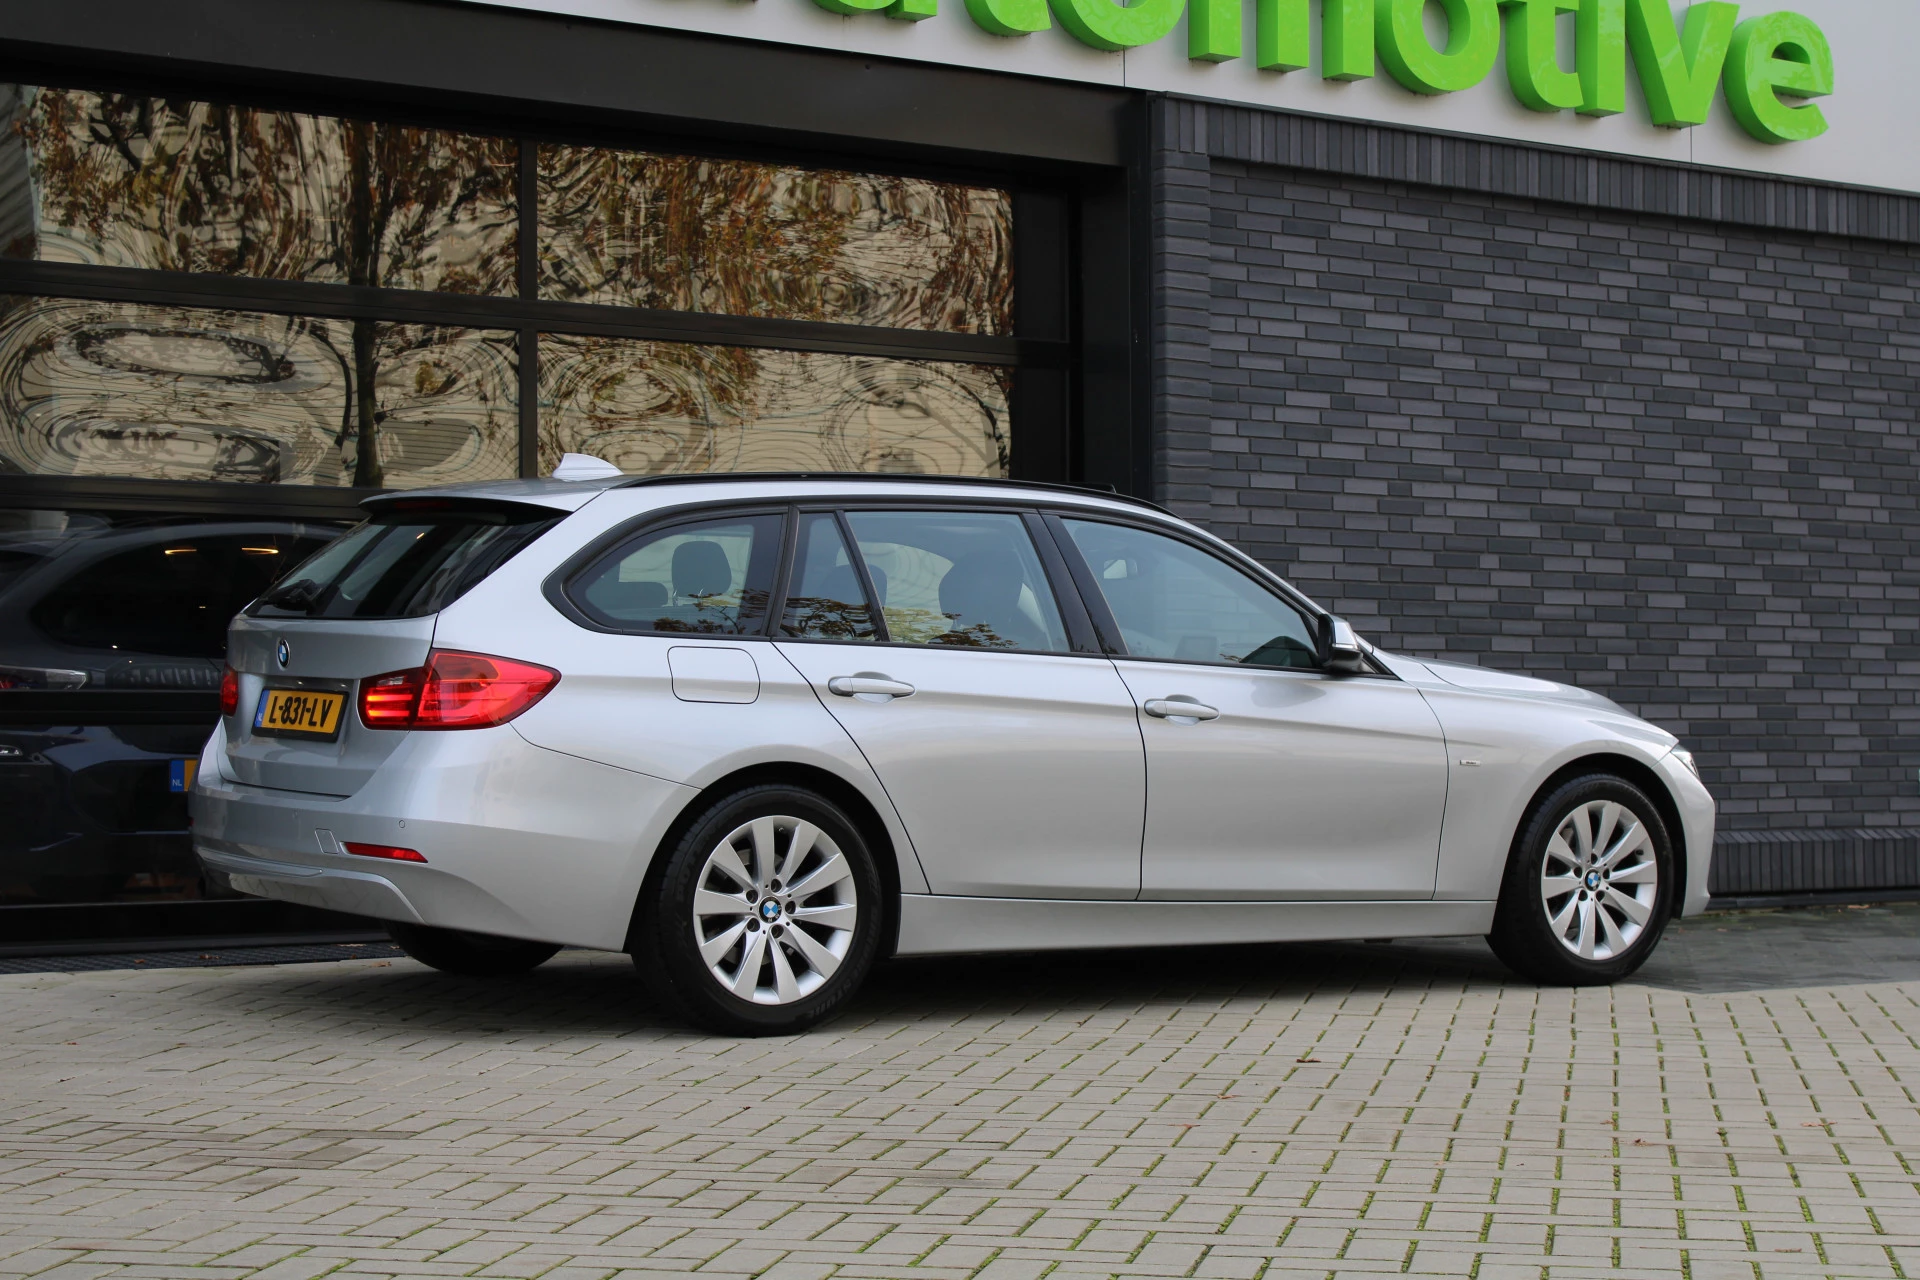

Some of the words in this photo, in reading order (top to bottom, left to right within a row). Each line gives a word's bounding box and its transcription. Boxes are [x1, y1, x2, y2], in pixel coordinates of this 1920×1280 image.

[815, 0, 1835, 146] motive
[268, 695, 334, 728] L-831-LV
[172, 779, 183, 787] NL
